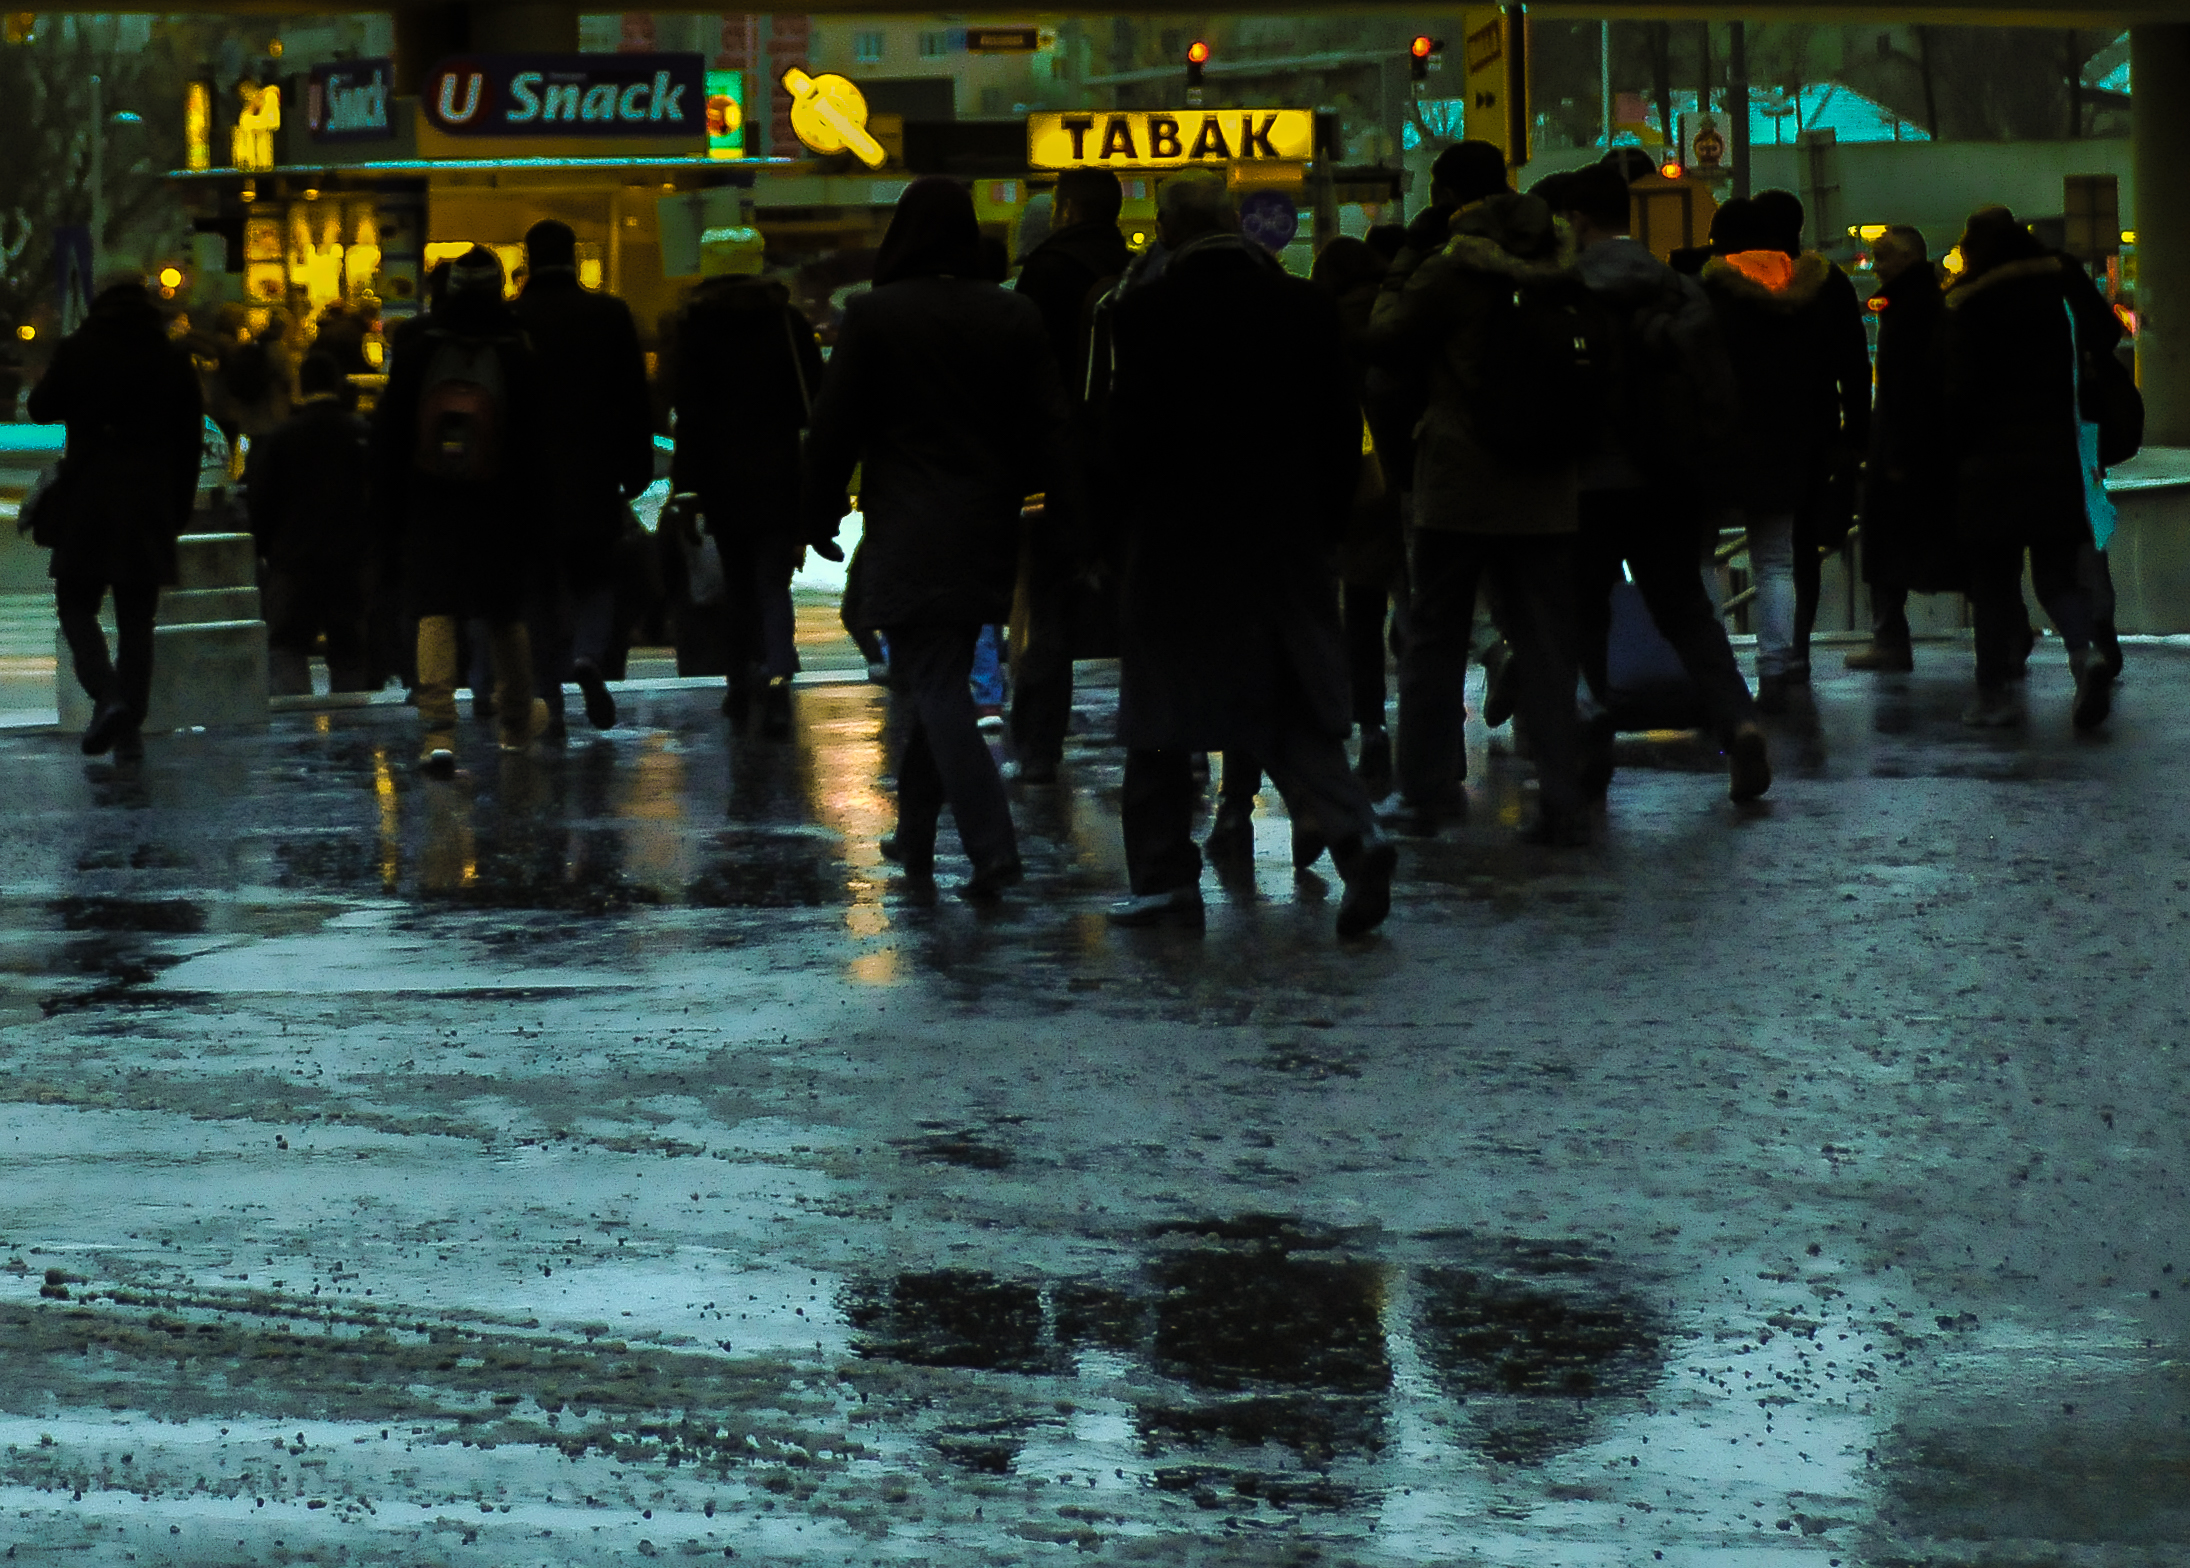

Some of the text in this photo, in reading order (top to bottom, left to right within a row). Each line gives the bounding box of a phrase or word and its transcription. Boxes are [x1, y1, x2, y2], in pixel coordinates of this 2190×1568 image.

[438, 70, 687, 122] U Snack
[1062, 112, 1282, 160] TABAK
